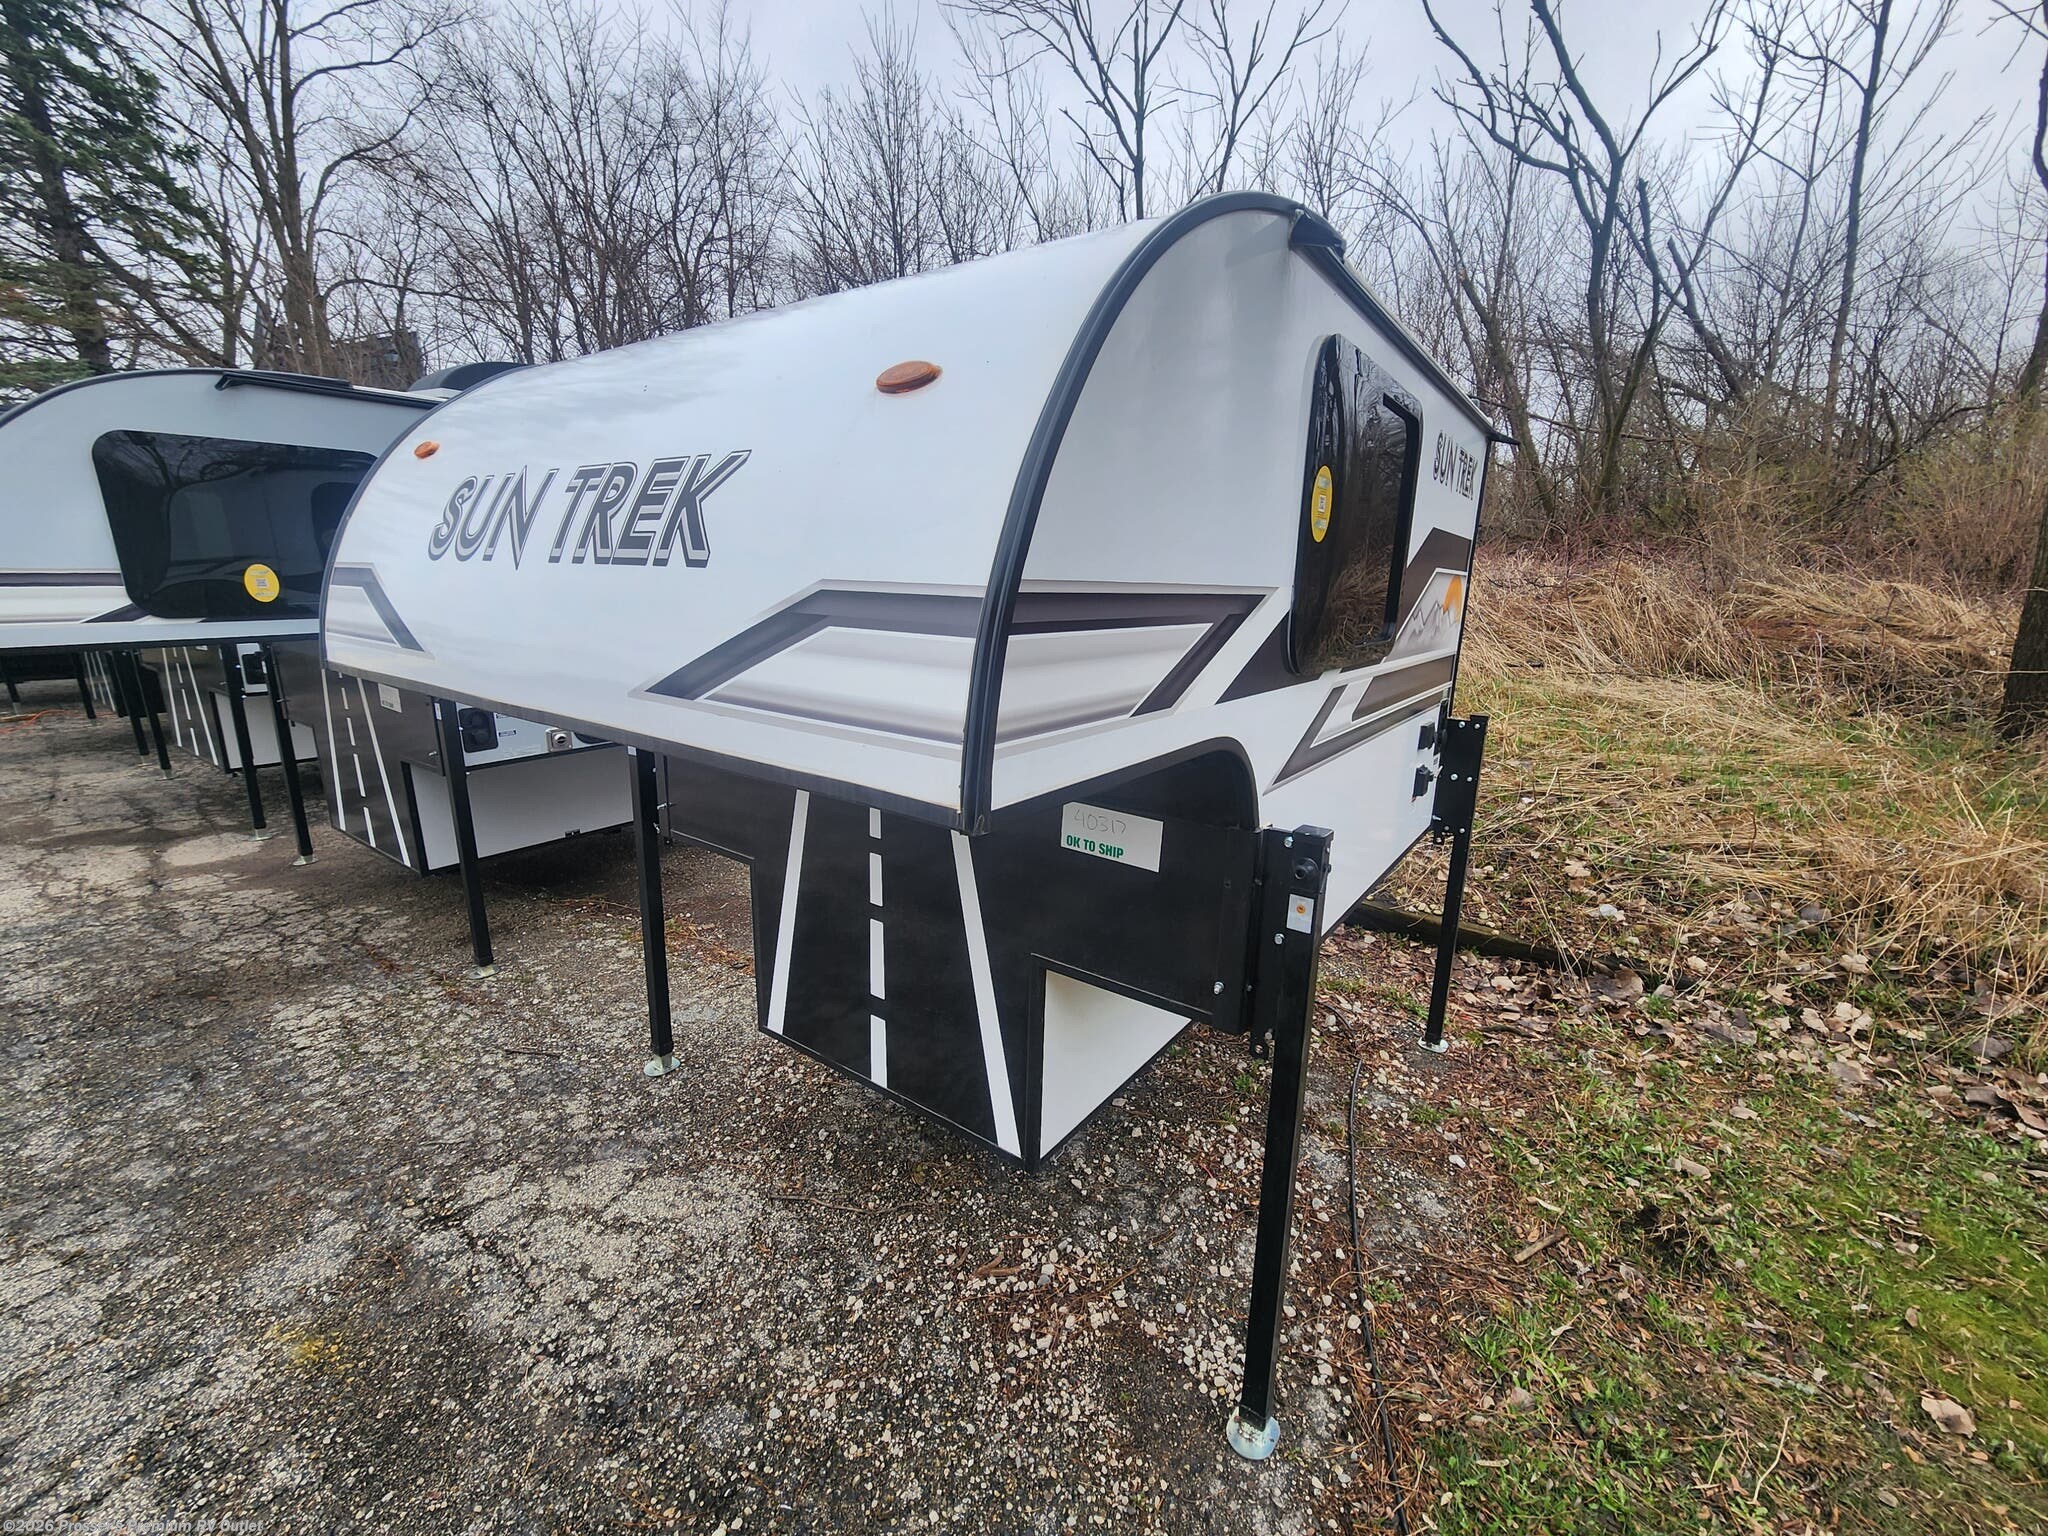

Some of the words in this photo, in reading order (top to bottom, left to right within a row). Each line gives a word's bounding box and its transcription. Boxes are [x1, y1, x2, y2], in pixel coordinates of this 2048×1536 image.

[1432, 430, 1459, 493] SUN
[1455, 447, 1478, 501] TREK
[428, 465, 560, 570] SUN
[548, 449, 752, 568] TREK
[1073, 808, 1127, 834] 40317
[1066, 835, 1081, 848] OK
[1083, 839, 1096, 852] TO
[1098, 843, 1124, 858] SHIP
